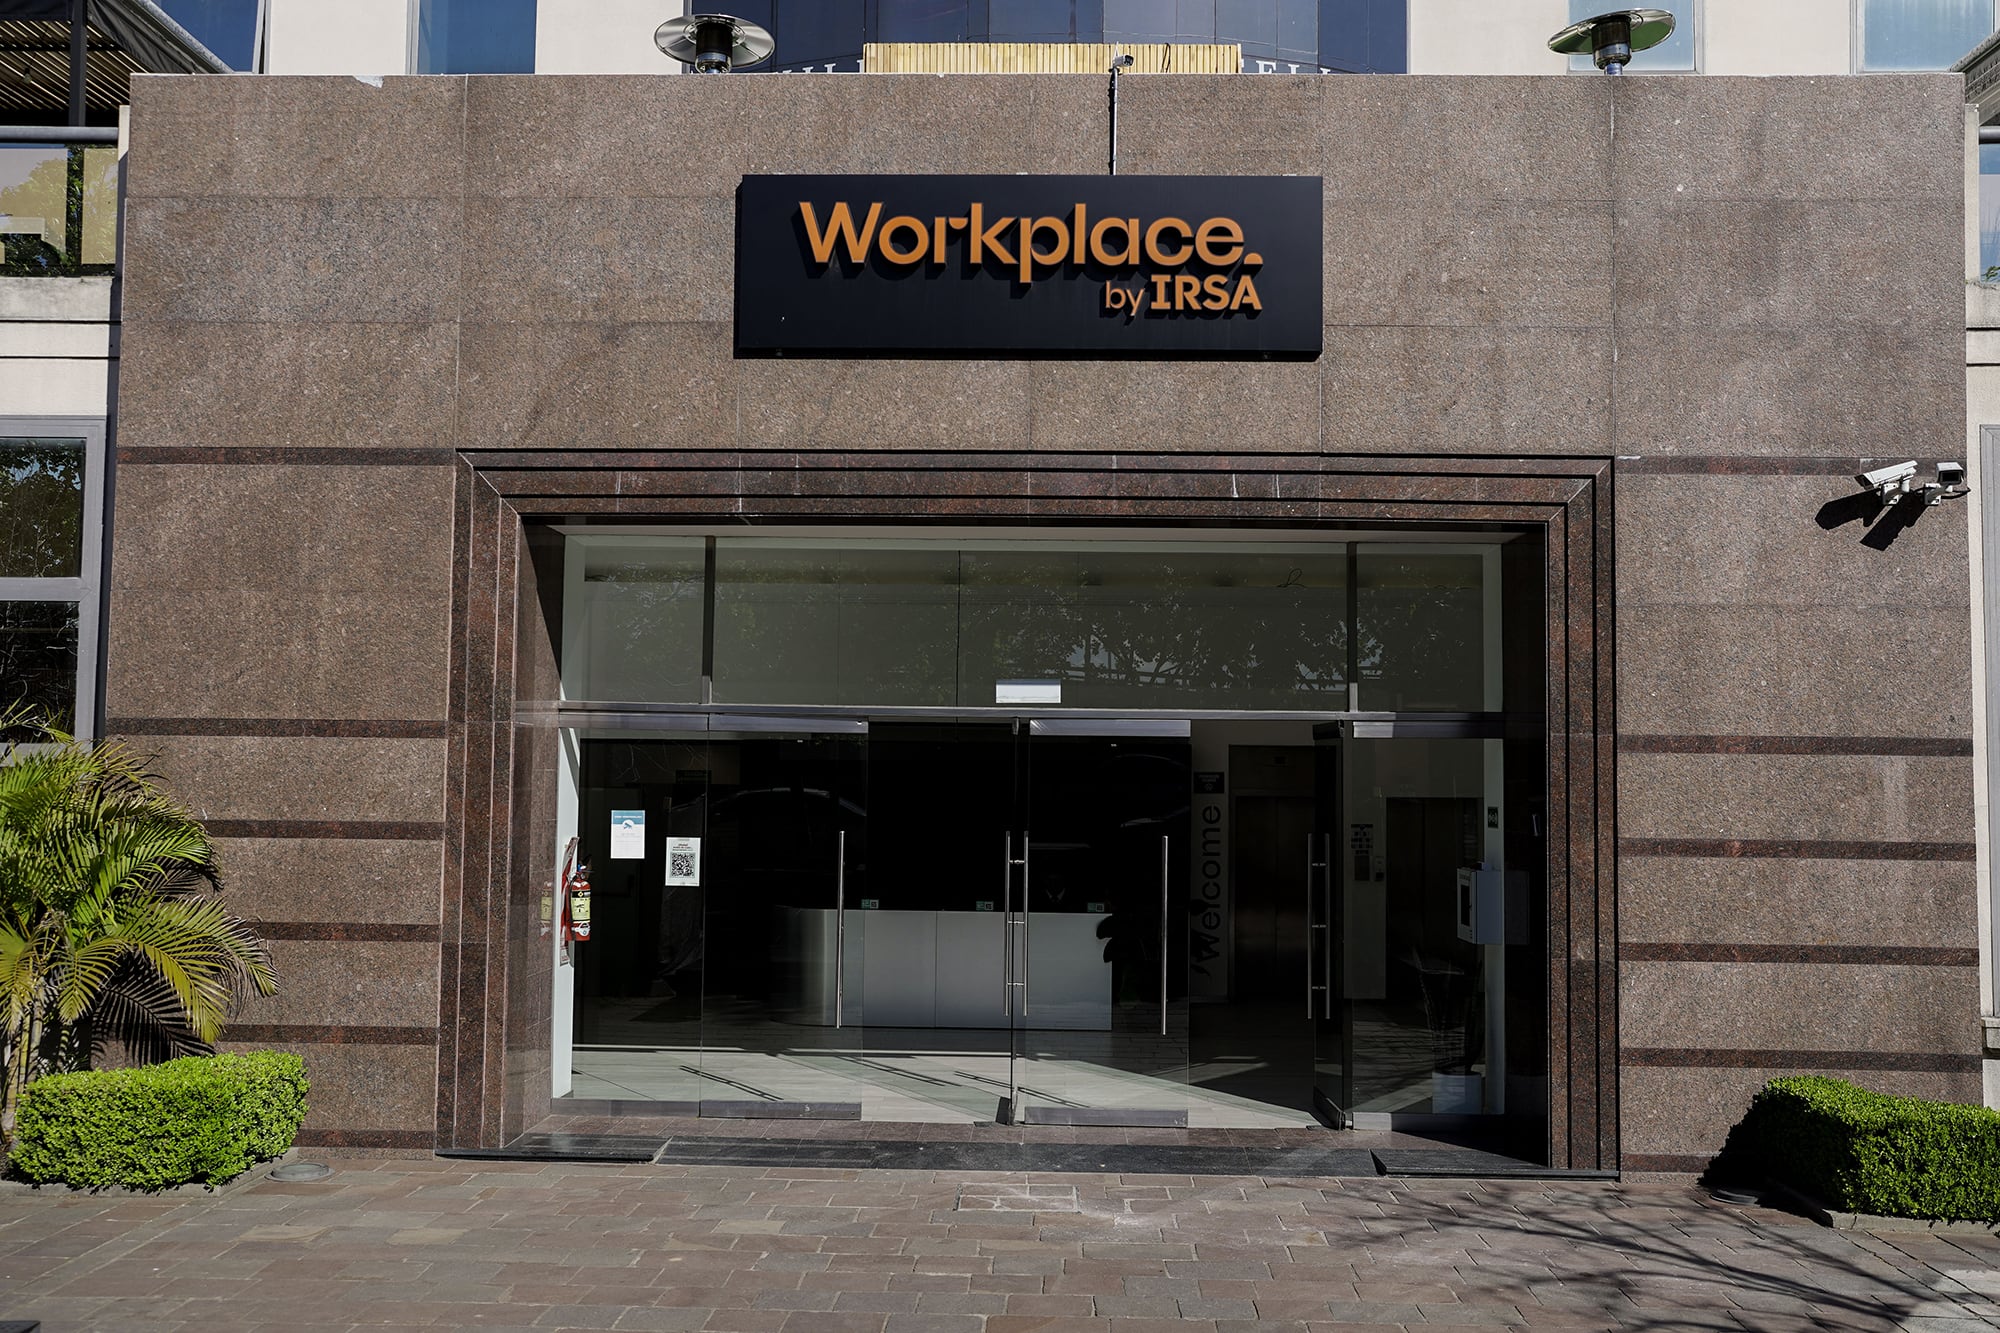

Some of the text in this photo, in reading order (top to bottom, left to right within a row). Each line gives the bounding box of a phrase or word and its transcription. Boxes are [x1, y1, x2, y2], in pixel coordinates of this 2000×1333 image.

[799, 202, 1263, 283] Workplace.
[1105, 274, 1262, 316] by IRSA
